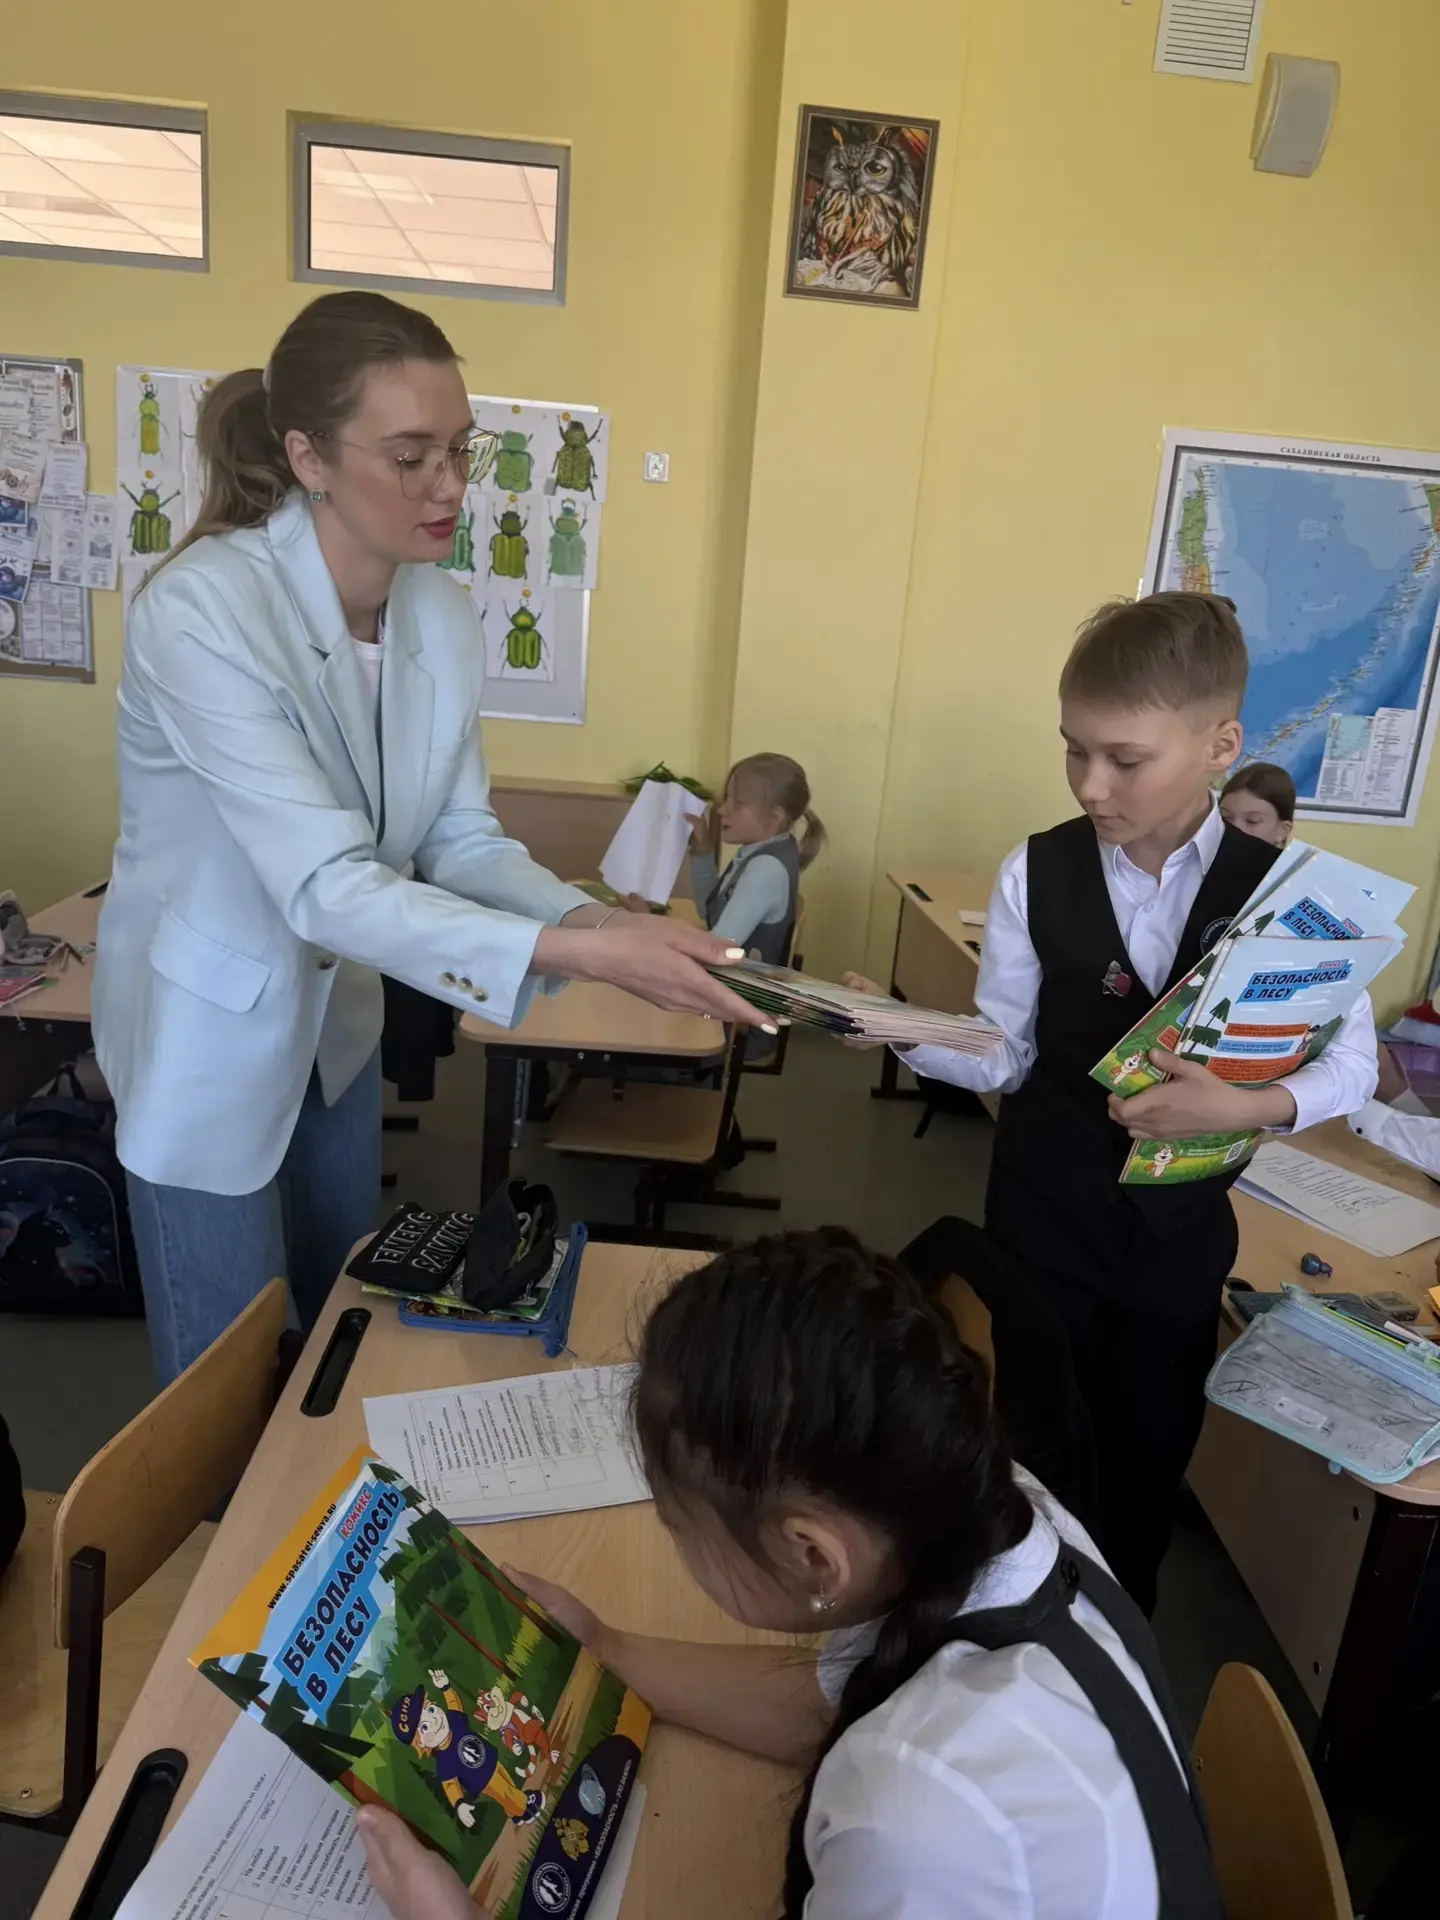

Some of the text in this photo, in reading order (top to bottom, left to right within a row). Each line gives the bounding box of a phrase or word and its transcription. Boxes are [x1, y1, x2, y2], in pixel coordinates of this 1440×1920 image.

[1280, 446, 1381, 462] САХАЛИНСКАЯ ОБЛАСТЬ
[1283, 910, 1316, 937] В ЛЕСУ
[1297, 899, 1350, 939] БЕЗОПАСНОС
[1243, 987, 1292, 999] В ЛЕСУ
[1251, 968, 1347, 985] БЕЗОПАСНОСТЬ
[412, 1212, 474, 1272] SAVING
[340, 1488, 372, 1538] КОМИКС
[282, 1491, 399, 1677] БЕЗОПАСНОСТЬ
[306, 1595, 371, 1702] В ЛЕСУ
